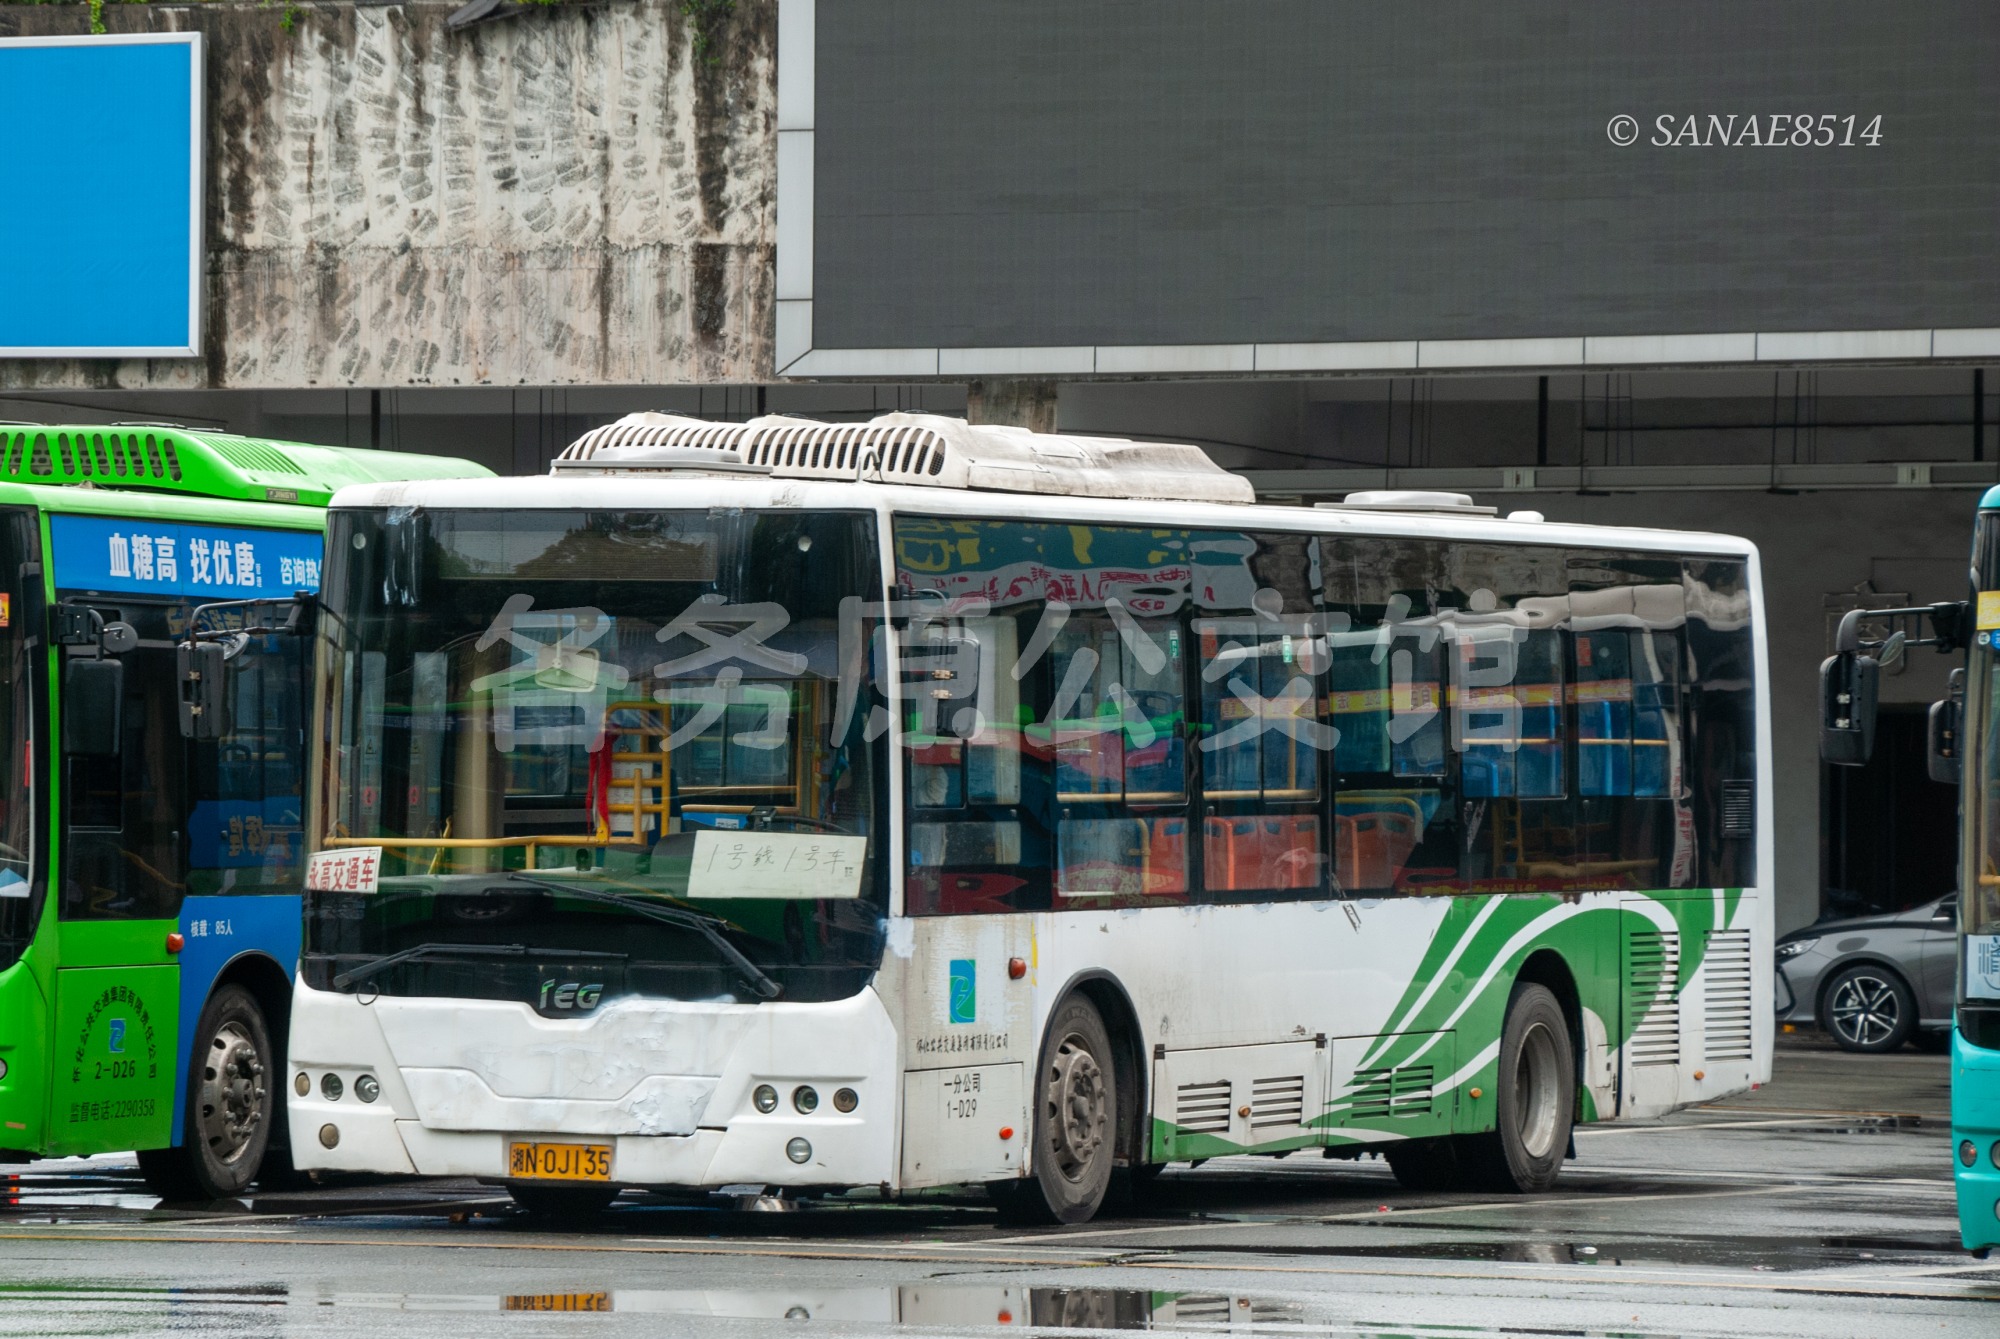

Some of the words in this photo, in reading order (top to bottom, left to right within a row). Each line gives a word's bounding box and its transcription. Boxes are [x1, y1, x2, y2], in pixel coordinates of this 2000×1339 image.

[108, 532, 177, 582] 血糖高
[189, 537, 255, 587] 找优唐
[280, 556, 322, 587] 咨询热
[95, 1060, 136, 1080] 2-D26
[944, 1073, 980, 1094] 一分公司
[947, 1099, 977, 1119] 1-D29
